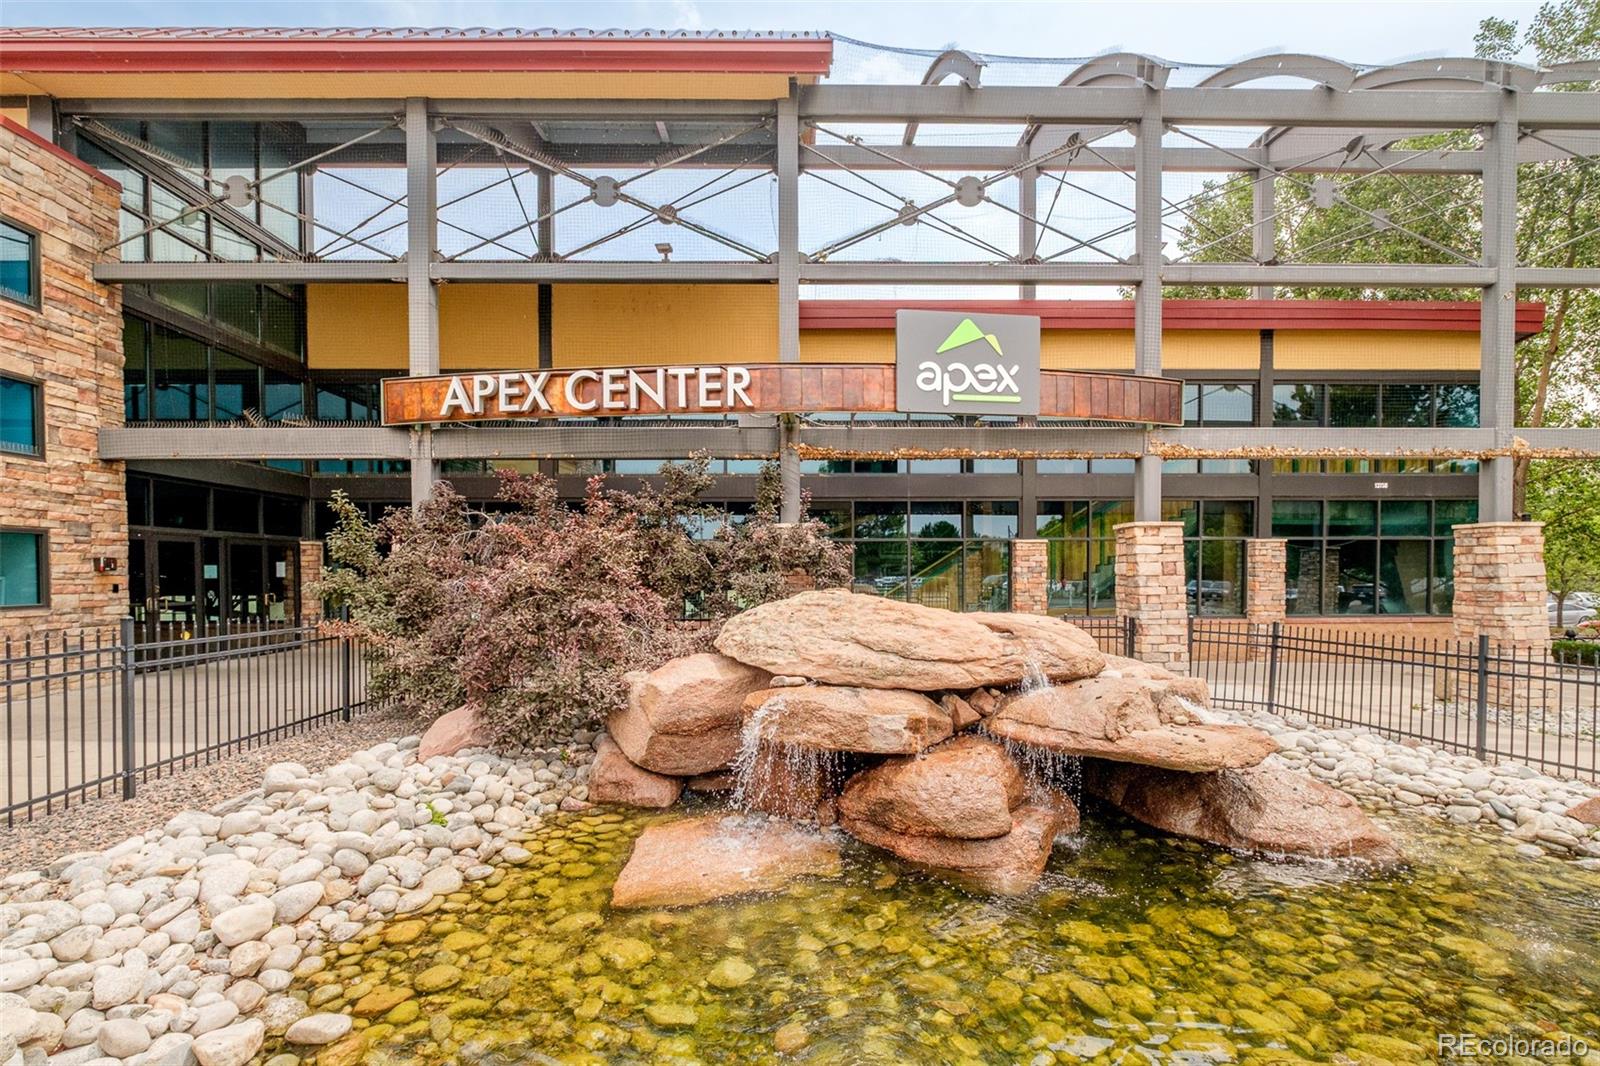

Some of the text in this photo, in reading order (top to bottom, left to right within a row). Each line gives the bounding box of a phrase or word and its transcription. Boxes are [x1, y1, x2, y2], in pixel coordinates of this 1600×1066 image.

[440, 366, 754, 416] APEX CENTER
[916, 361, 1019, 406] apex
